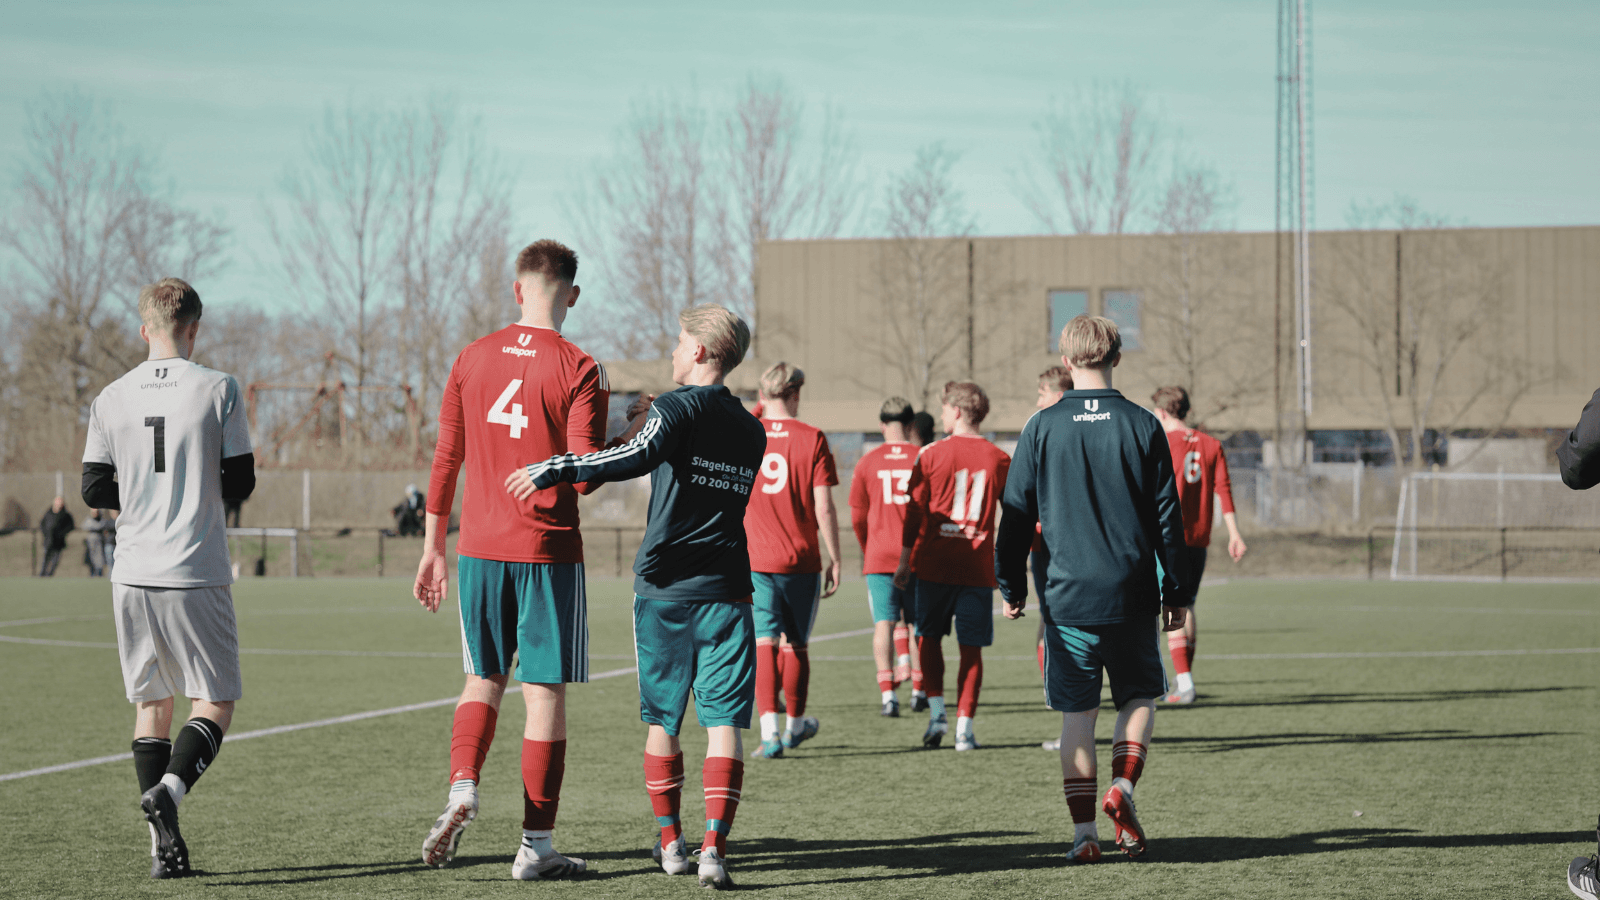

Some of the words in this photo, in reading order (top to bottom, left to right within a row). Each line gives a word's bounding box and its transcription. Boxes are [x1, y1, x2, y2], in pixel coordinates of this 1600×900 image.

[502, 346, 537, 357] unisport
[140, 381, 178, 390] unisport
[487, 378, 529, 439] 4
[1072, 411, 1111, 423] unisport
[144, 416, 166, 473] 1
[691, 456, 737, 474] Slagelse
[739, 466, 754, 479] Lift
[761, 452, 788, 494] 9
[1184, 451, 1202, 484] 6
[691, 474, 707, 485] 70
[708, 477, 730, 490] 200
[732, 483, 749, 495] 433
[877, 469, 913, 505] 13
[950, 468, 987, 522] 11
